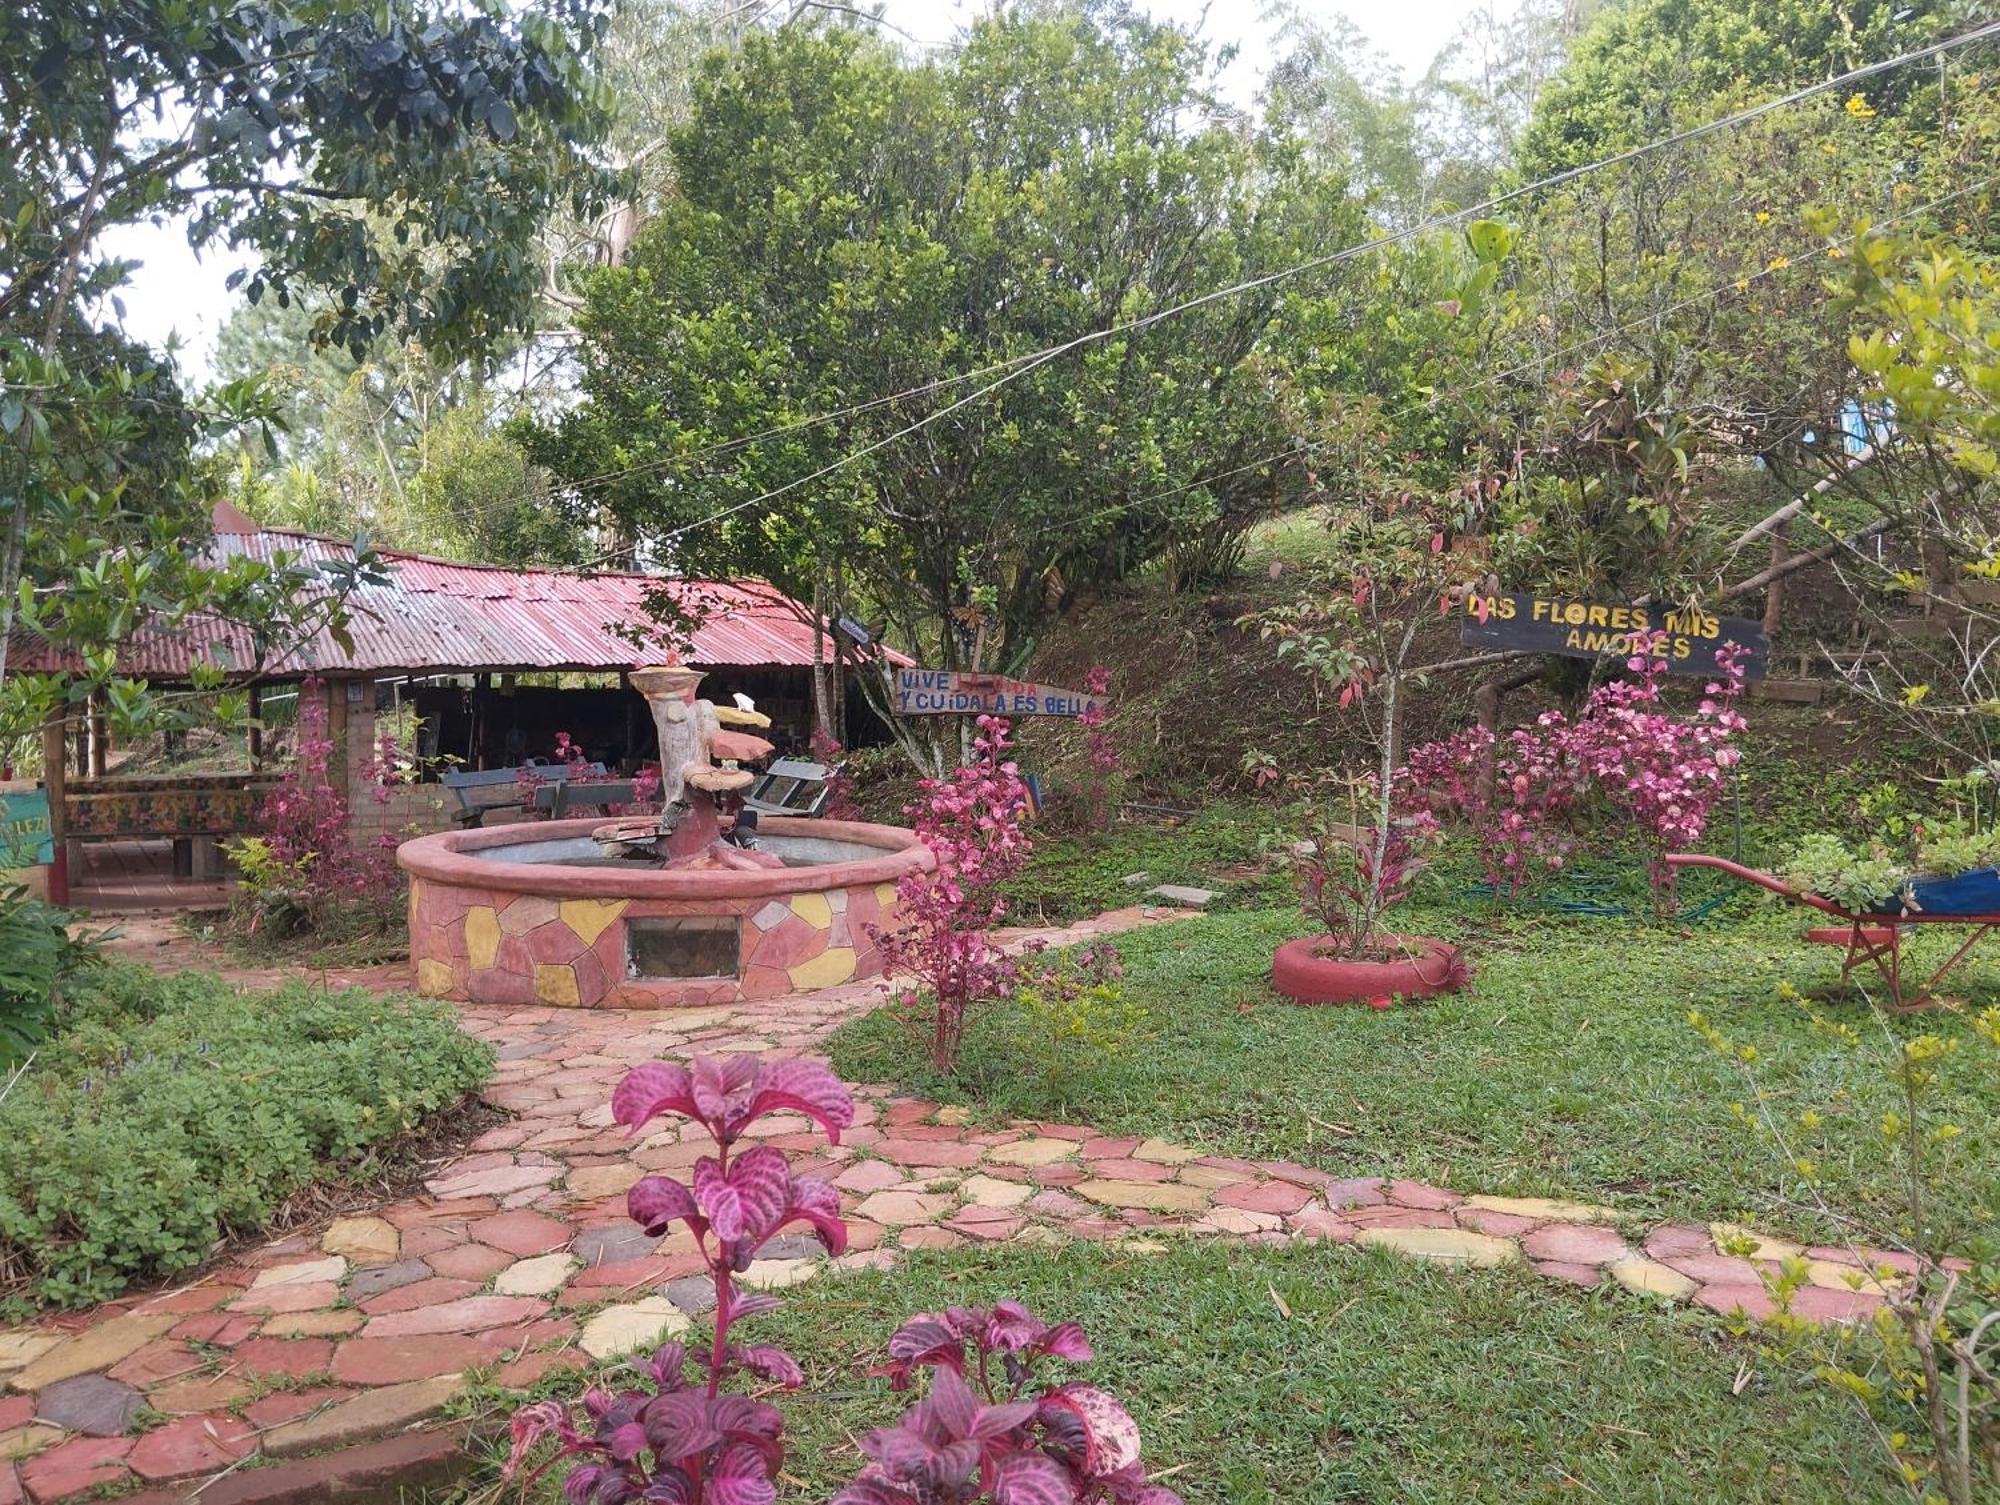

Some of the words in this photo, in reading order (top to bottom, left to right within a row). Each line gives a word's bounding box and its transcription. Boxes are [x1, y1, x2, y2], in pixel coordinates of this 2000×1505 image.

[1466, 593, 1516, 619] LAS
[1533, 600, 1650, 631] FLORES
[1665, 614, 1721, 640] MIS
[900, 691, 911, 711] Y
[1014, 695, 1037, 712] ES
[1045, 697, 1097, 714] BELLA
